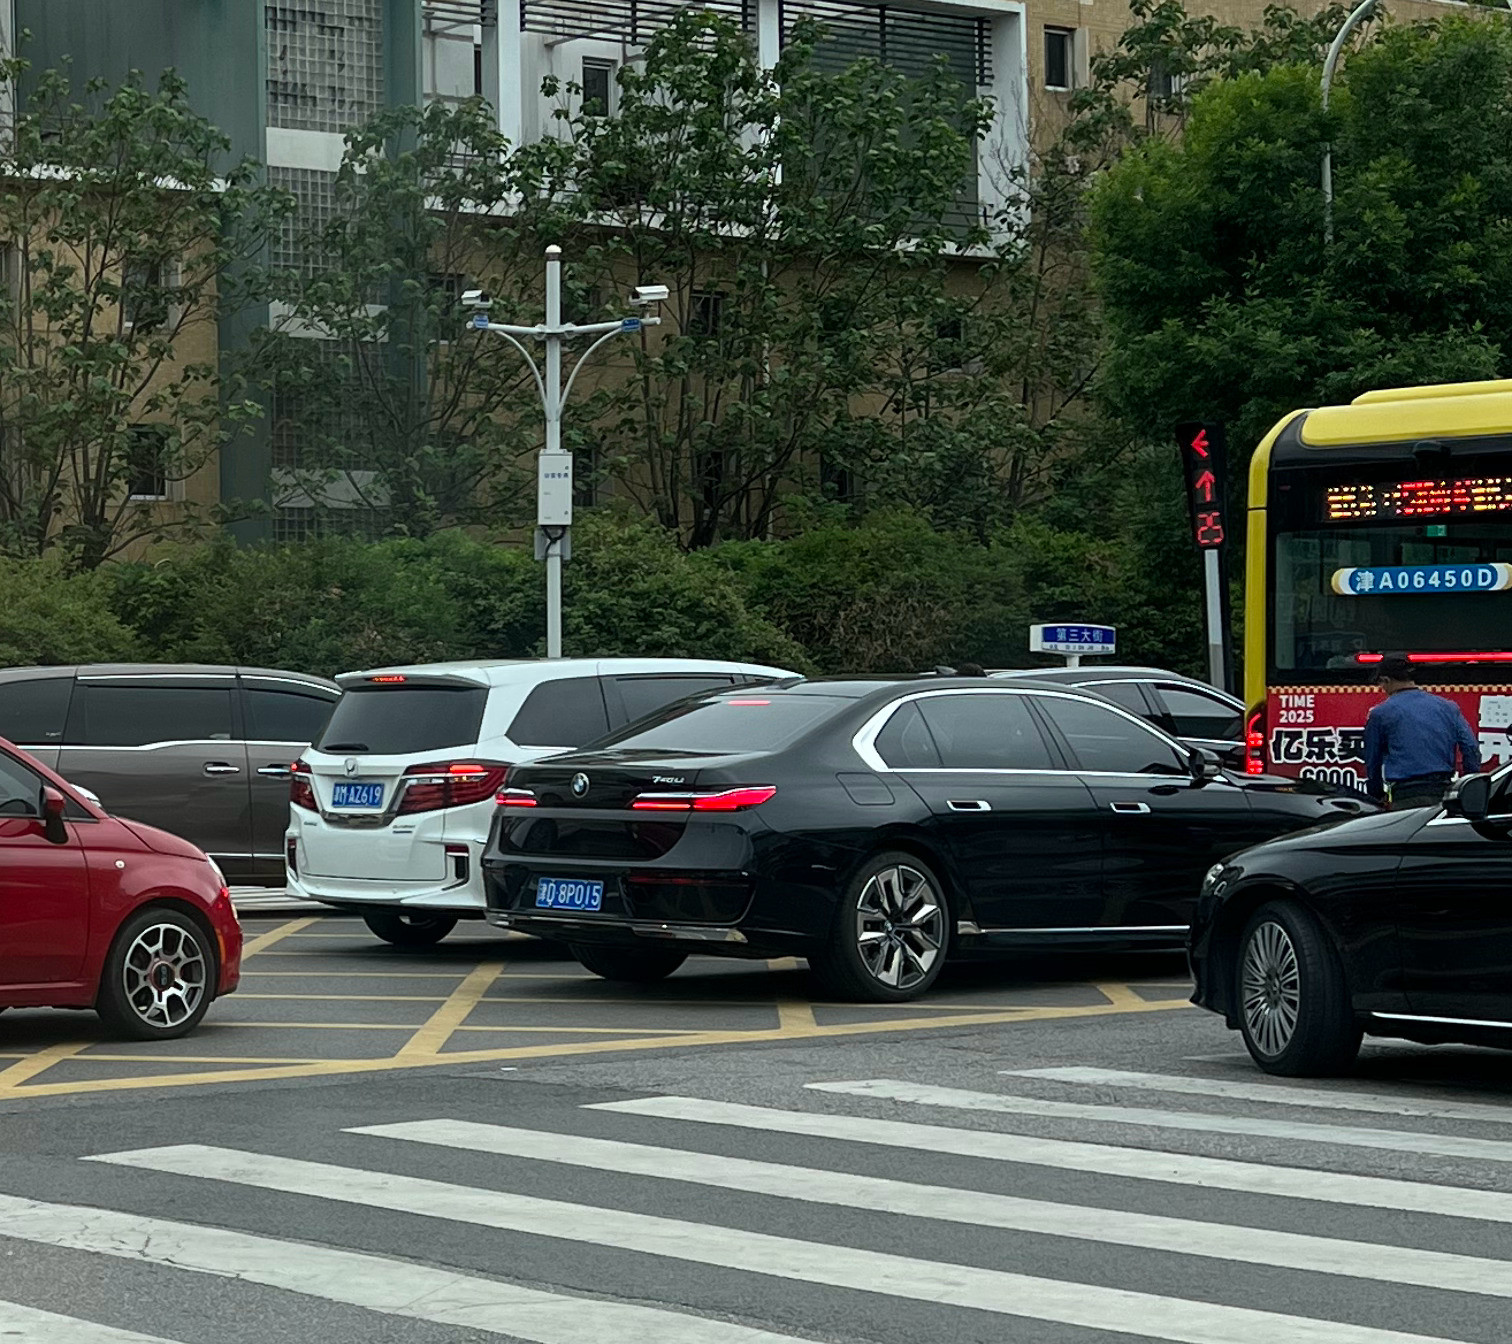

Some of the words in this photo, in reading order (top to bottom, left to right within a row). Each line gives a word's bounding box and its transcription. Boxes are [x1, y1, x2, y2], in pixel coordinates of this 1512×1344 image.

[1355, 568, 1492, 592] 津A06450D
[1056, 627, 1103, 643] 第三大街
[1279, 695, 1315, 708] TIME
[1279, 709, 1314, 723] 2025
